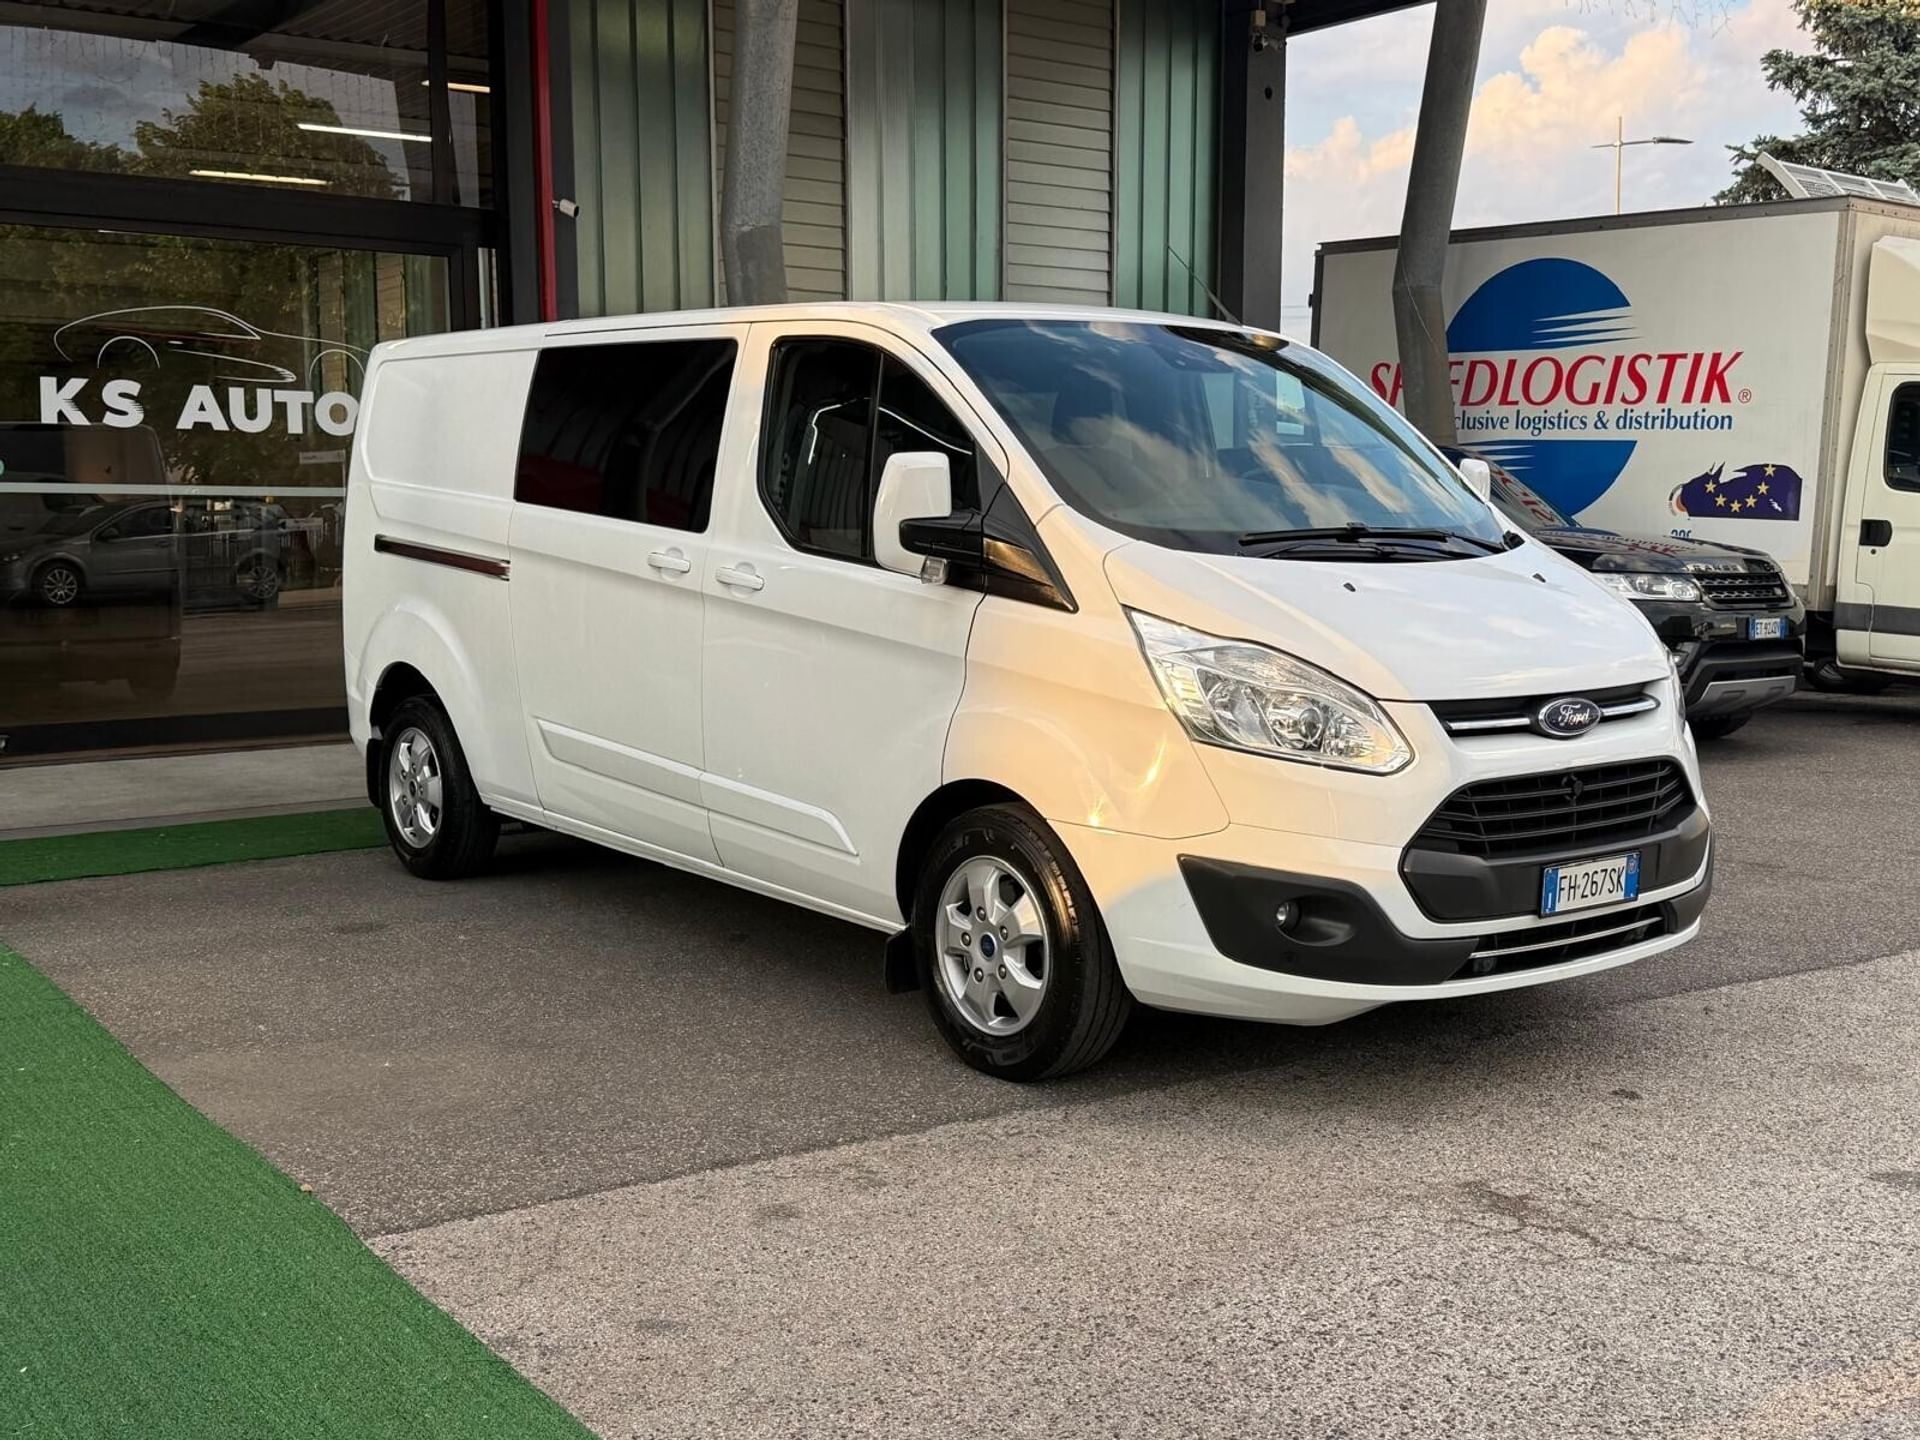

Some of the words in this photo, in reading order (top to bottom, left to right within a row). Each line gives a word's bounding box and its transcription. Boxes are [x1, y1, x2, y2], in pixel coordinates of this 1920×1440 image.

[1371, 351, 1744, 407] SDLOGISTIK
[40, 376, 144, 428] KS
[176, 384, 359, 436] AUTO
[1455, 410, 1509, 430] clusive
[1515, 409, 1587, 436] logistics
[1593, 410, 1610, 430] &
[1615, 408, 1733, 430] distribution
[1558, 704, 1590, 727] Ford
